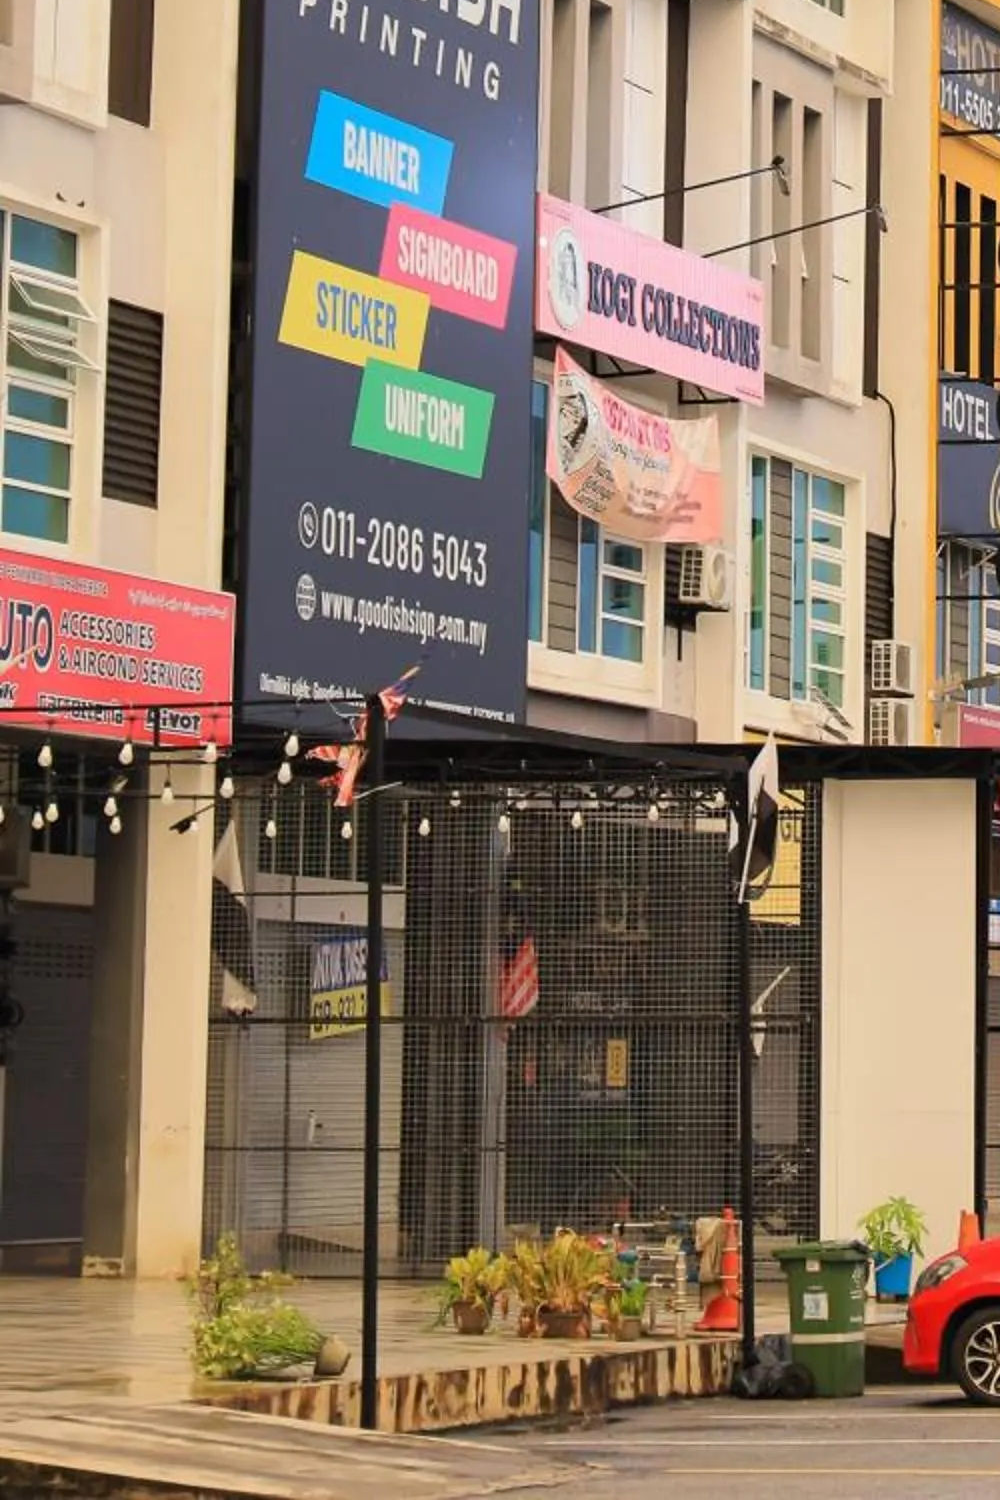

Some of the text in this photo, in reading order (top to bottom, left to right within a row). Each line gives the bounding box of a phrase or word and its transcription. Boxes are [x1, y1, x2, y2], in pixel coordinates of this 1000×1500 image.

[342, 119, 421, 195] BANNER
[397, 224, 498, 303] SIGNBOARD
[316, 280, 398, 352] STICKER
[587, 260, 761, 372] KOGI COLLECTIONS
[384, 382, 465, 451] UNIFORM
[942, 386, 996, 441] HOTEL
[321, 506, 488, 588] 011-2086 5043
[59, 608, 156, 650] ACCESSORIES
[58, 644, 204, 694] & AIRCOND SERVICES
